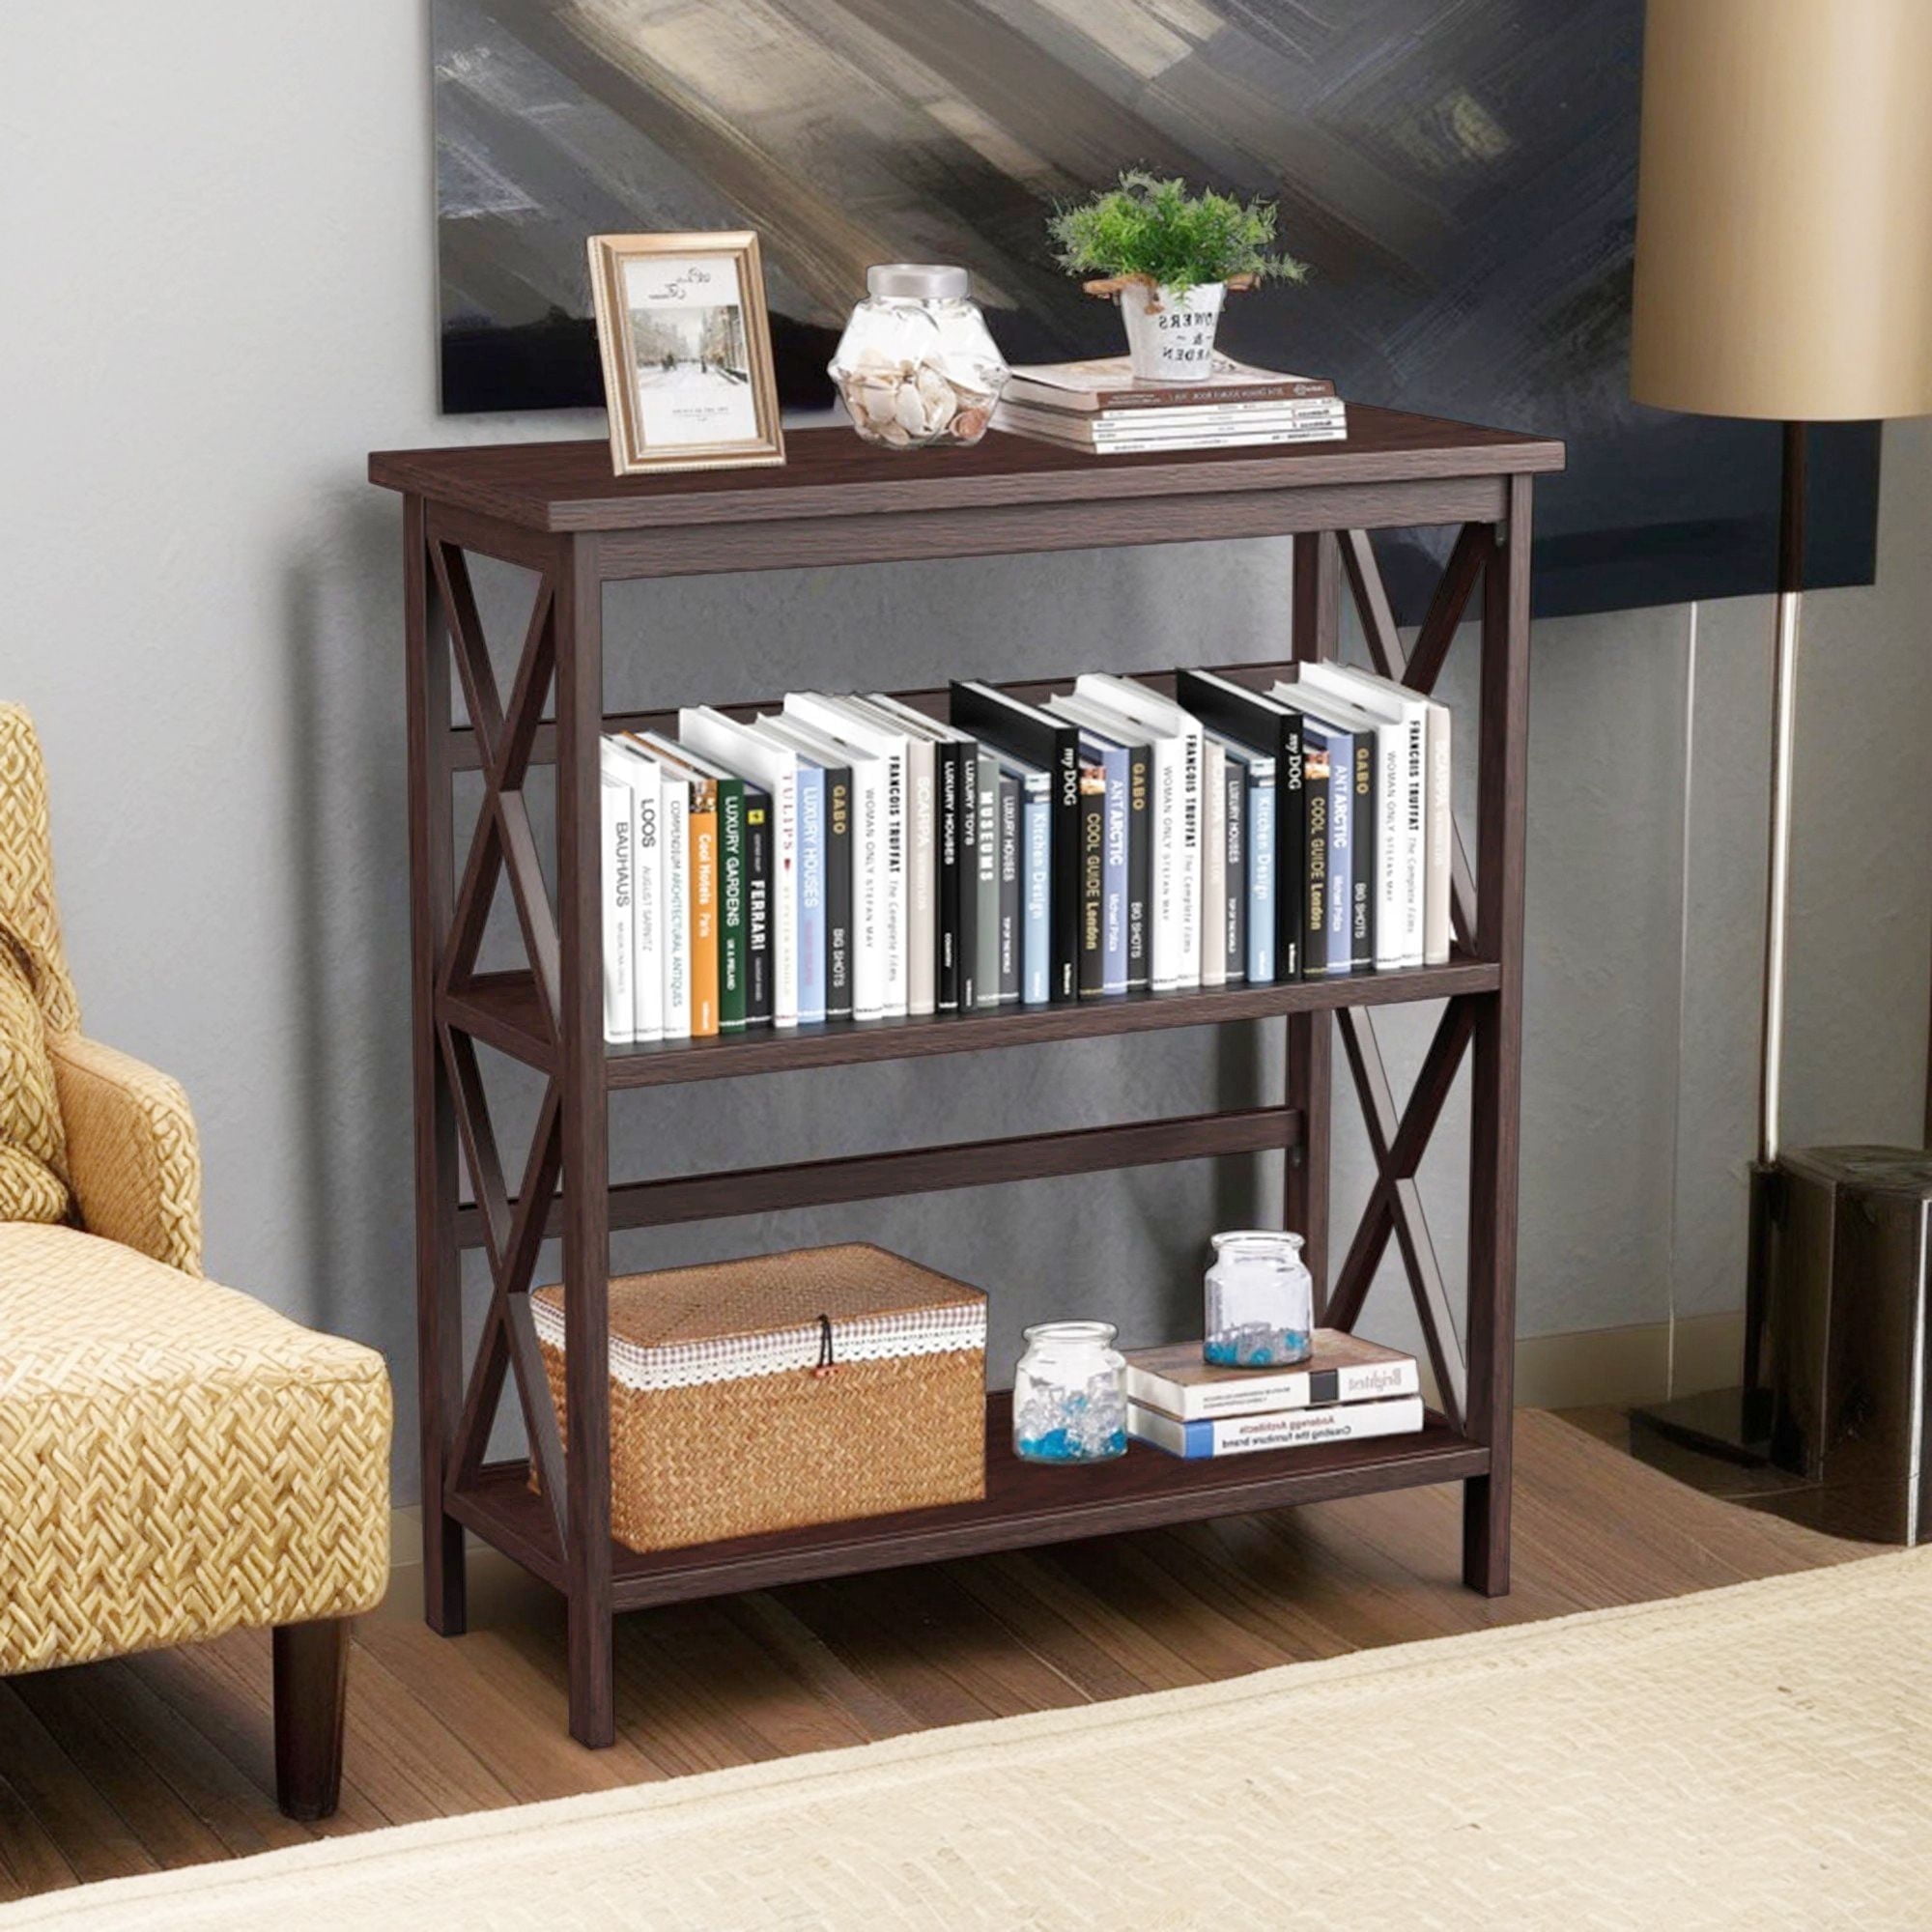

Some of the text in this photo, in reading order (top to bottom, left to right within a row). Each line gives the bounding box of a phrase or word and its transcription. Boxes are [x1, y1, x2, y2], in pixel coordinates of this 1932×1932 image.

[1185, 734, 1197, 793] FRANCOIS
[1285, 733, 1301, 790] my DOG
[1356, 748, 1369, 794] GABO
[1386, 751, 1397, 798] WOMAN
[1409, 720, 1421, 778] FRANCOIS
[888, 755, 900, 816] FRANCOIS
[944, 760, 955, 810] LUXURY
[965, 760, 975, 846] LUXURY TOYS
[1062, 748, 1076, 807] my DOG
[1132, 762, 1146, 811] GABO
[1162, 766, 1173, 813] WOMAN
[1228, 780, 1239, 820] LUXURY
[640, 798, 656, 848] LOOS
[724, 796, 739, 852] LUXURY
[781, 773, 793, 850] TULIPS
[804, 786, 818, 844] LUXURY
[833, 785, 846, 835] GABO
[865, 787, 875, 837] WOMAN
[1003, 796, 1014, 837] LUXURY
[1109, 780, 1123, 867] ANTARCTIC
[1162, 817, 1173, 849] ONLY
[1258, 796, 1270, 849] Kitchen
[1333, 765, 1348, 849] ANTARCTIC
[1386, 801, 1397, 833] ONLY
[615, 821, 631, 908] BAUHAUS
[698, 833, 712, 861] Cool
[865, 841, 875, 874] ONLY
[944, 813, 955, 865] HOUSES
[980, 791, 994, 882] MUSEUMS
[1002, 838, 1014, 882] HOUSES
[1228, 822, 1240, 864] HOUSES
[1310, 797, 1325, 930] COOL GUIDE London
[699, 865, 712, 905] Hotels
[724, 857, 740, 926] GARDENS
[804, 847, 819, 909] HOUSES
[1030, 811, 1046, 920] Kitchen Design
[1087, 812, 1100, 950] COOL GUIDE London
[751, 880, 765, 951] FERRARI
[1130, 902, 1143, 959] BIG SHOTS
[1354, 883, 1367, 939] BIG SHOTS
[833, 928, 844, 987] BIG SHOTS
